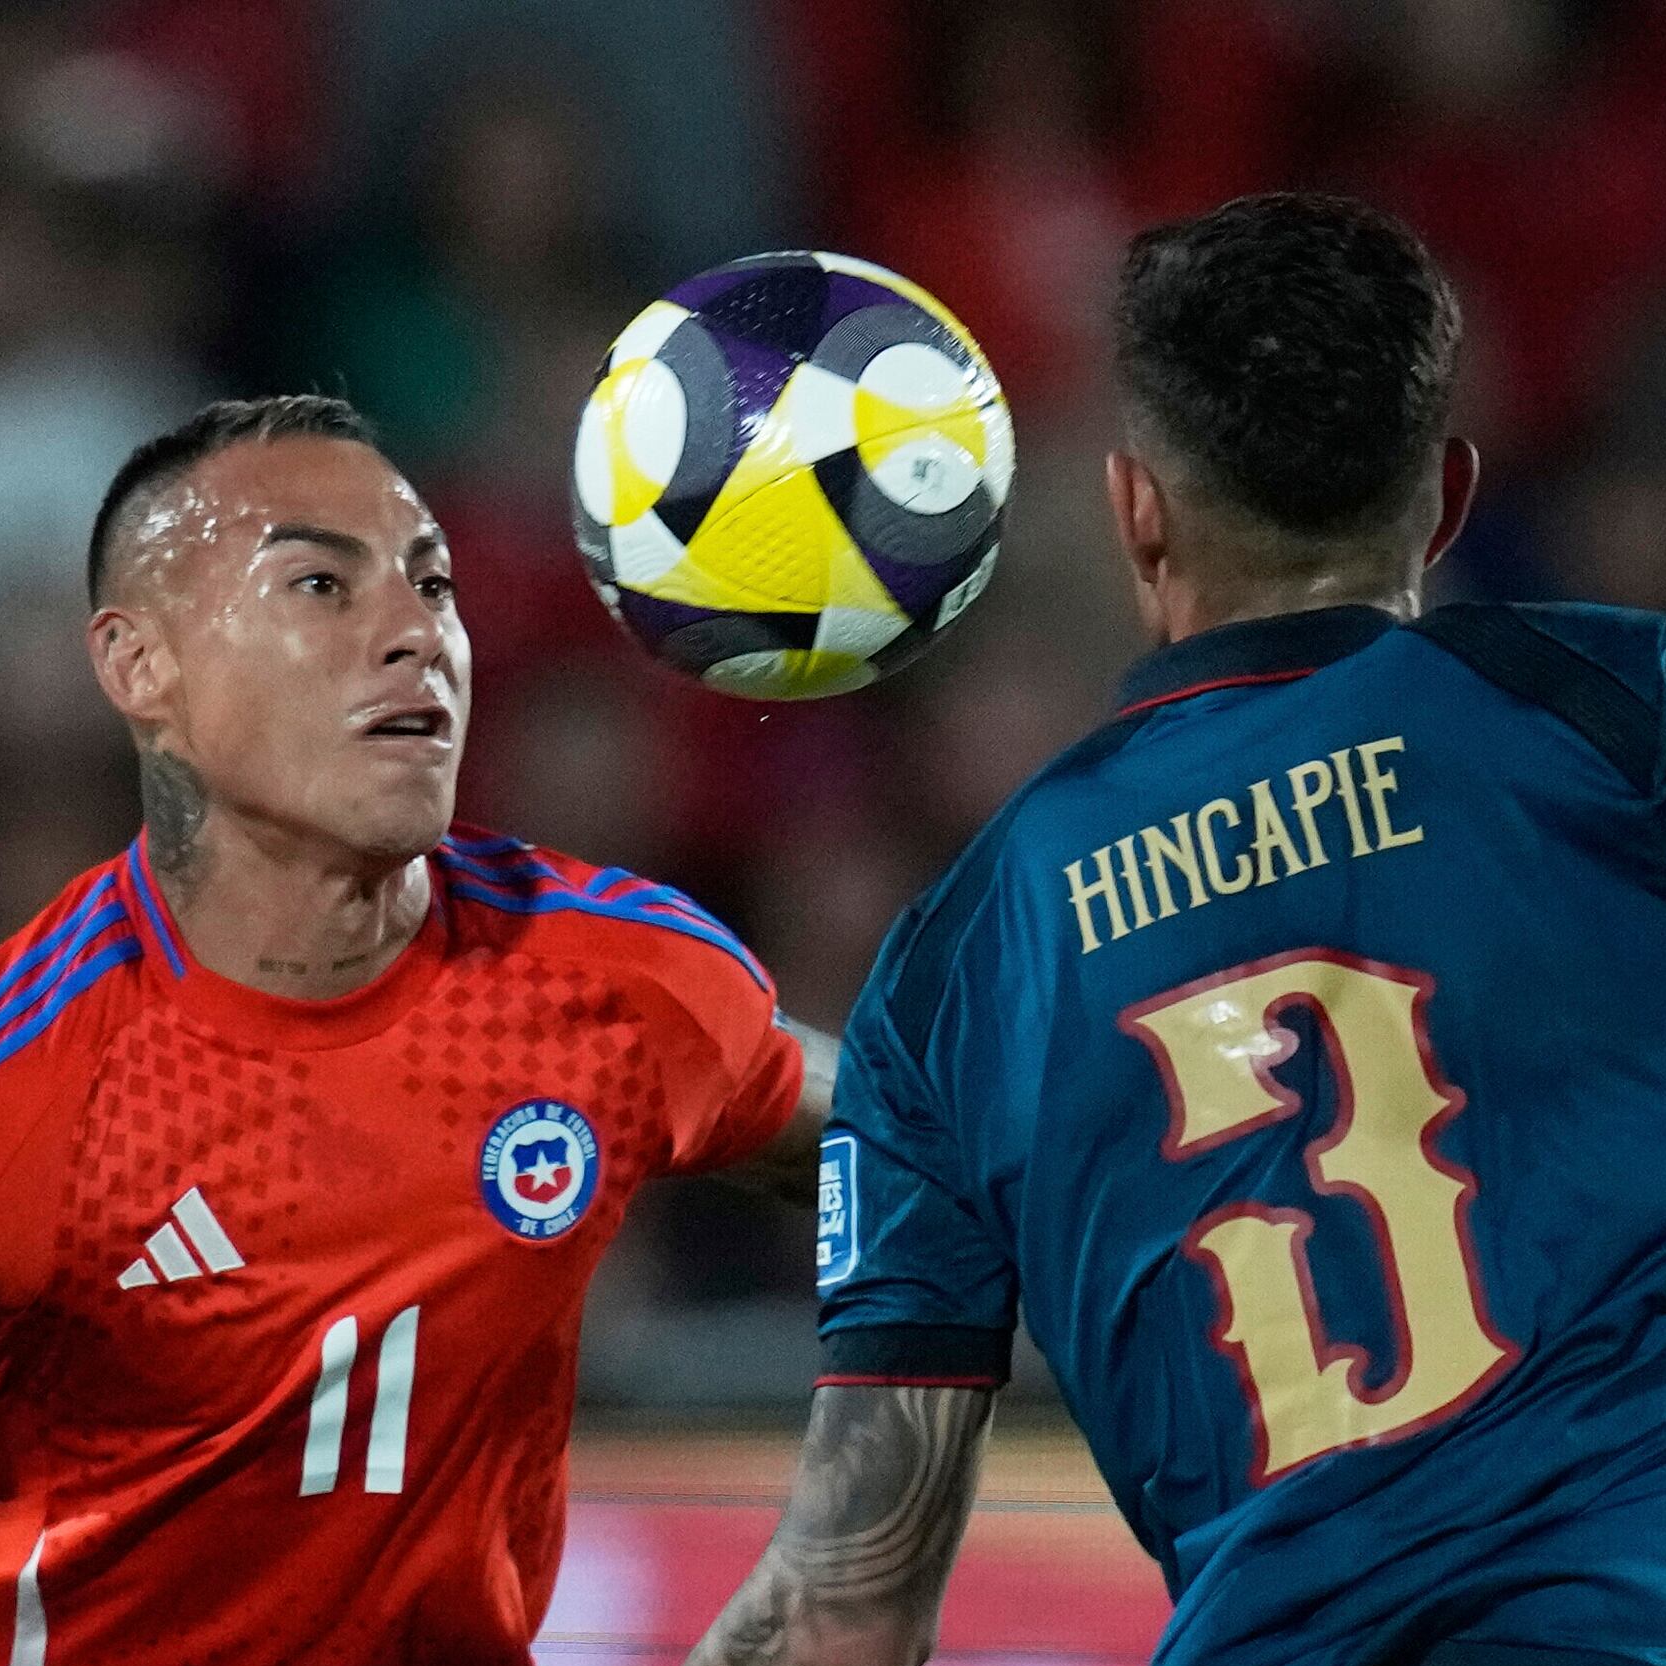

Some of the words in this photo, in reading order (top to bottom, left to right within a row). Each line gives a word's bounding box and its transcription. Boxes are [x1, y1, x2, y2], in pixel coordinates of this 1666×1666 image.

[1064, 736, 1424, 955] HINCAPIE
[1118, 947, 1521, 1487] 3
[299, 1305, 420, 1497] 11
